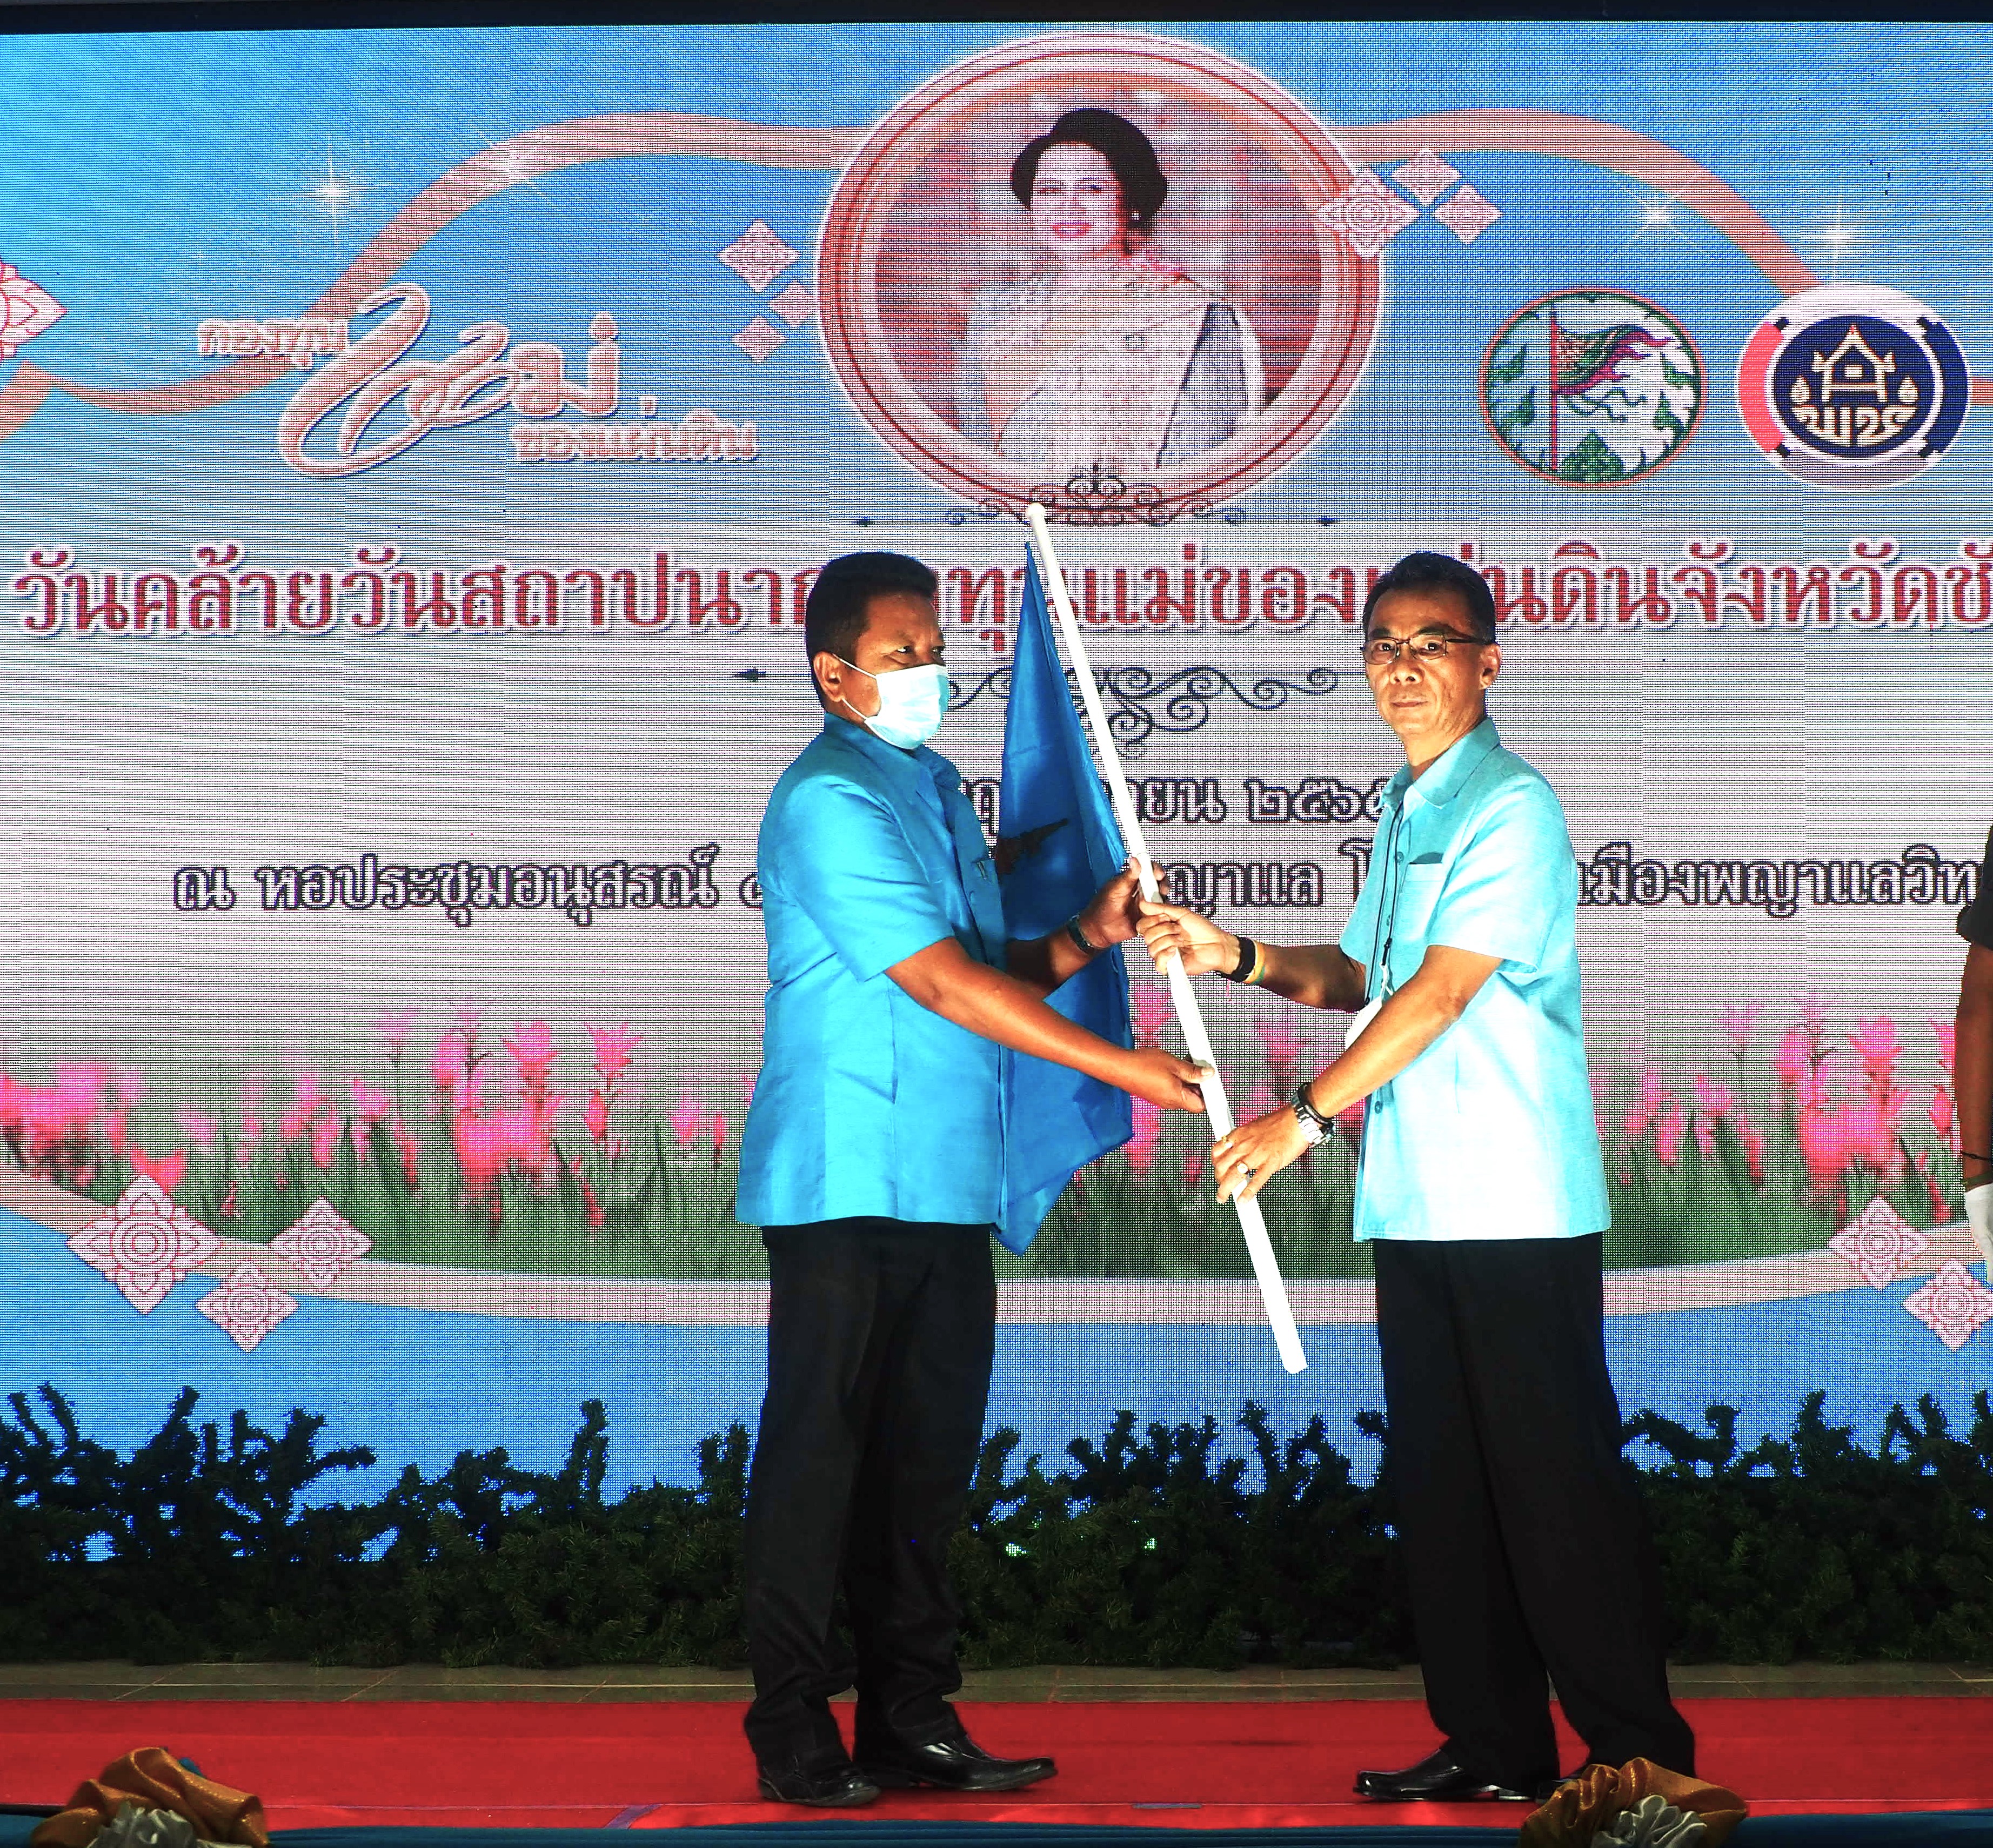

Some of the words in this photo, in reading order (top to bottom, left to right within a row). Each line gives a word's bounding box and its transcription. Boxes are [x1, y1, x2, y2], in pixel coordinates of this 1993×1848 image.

[255, 843, 721, 927] หอประชุมอนุสรณ์
